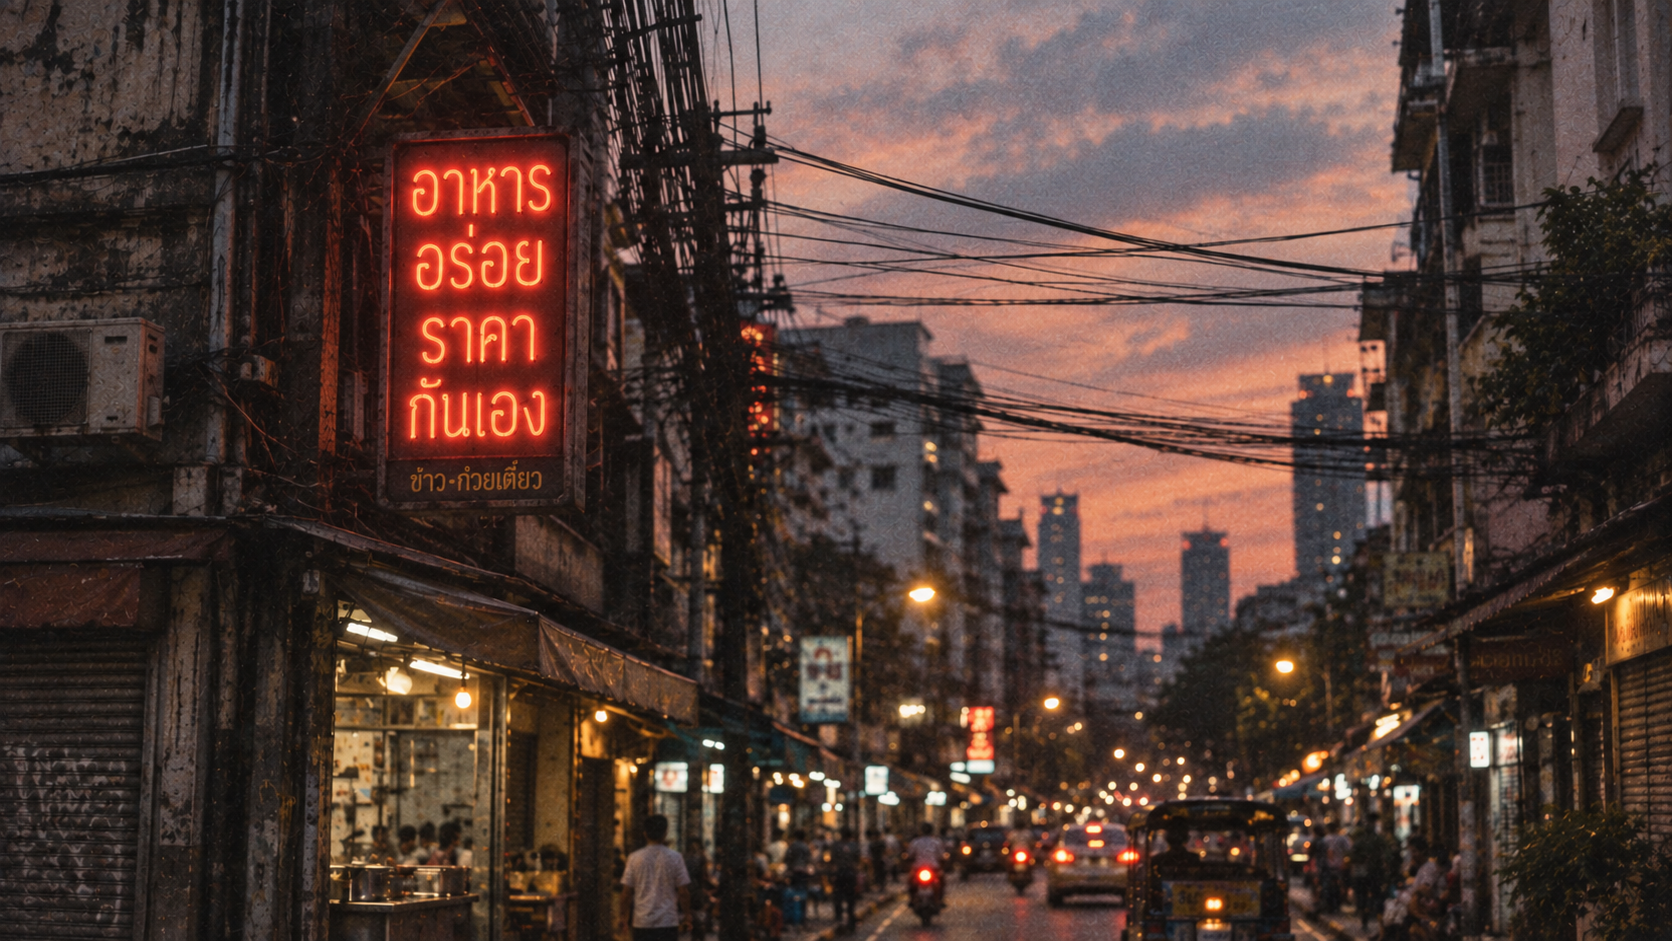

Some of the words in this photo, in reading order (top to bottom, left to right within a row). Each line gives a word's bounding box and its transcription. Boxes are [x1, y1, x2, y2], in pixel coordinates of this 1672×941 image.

[413, 164, 551, 216] อาหาร
[416, 223, 542, 290] อร่อย
[422, 315, 535, 363] ราคา
[410, 377, 545, 439] กันเอง
